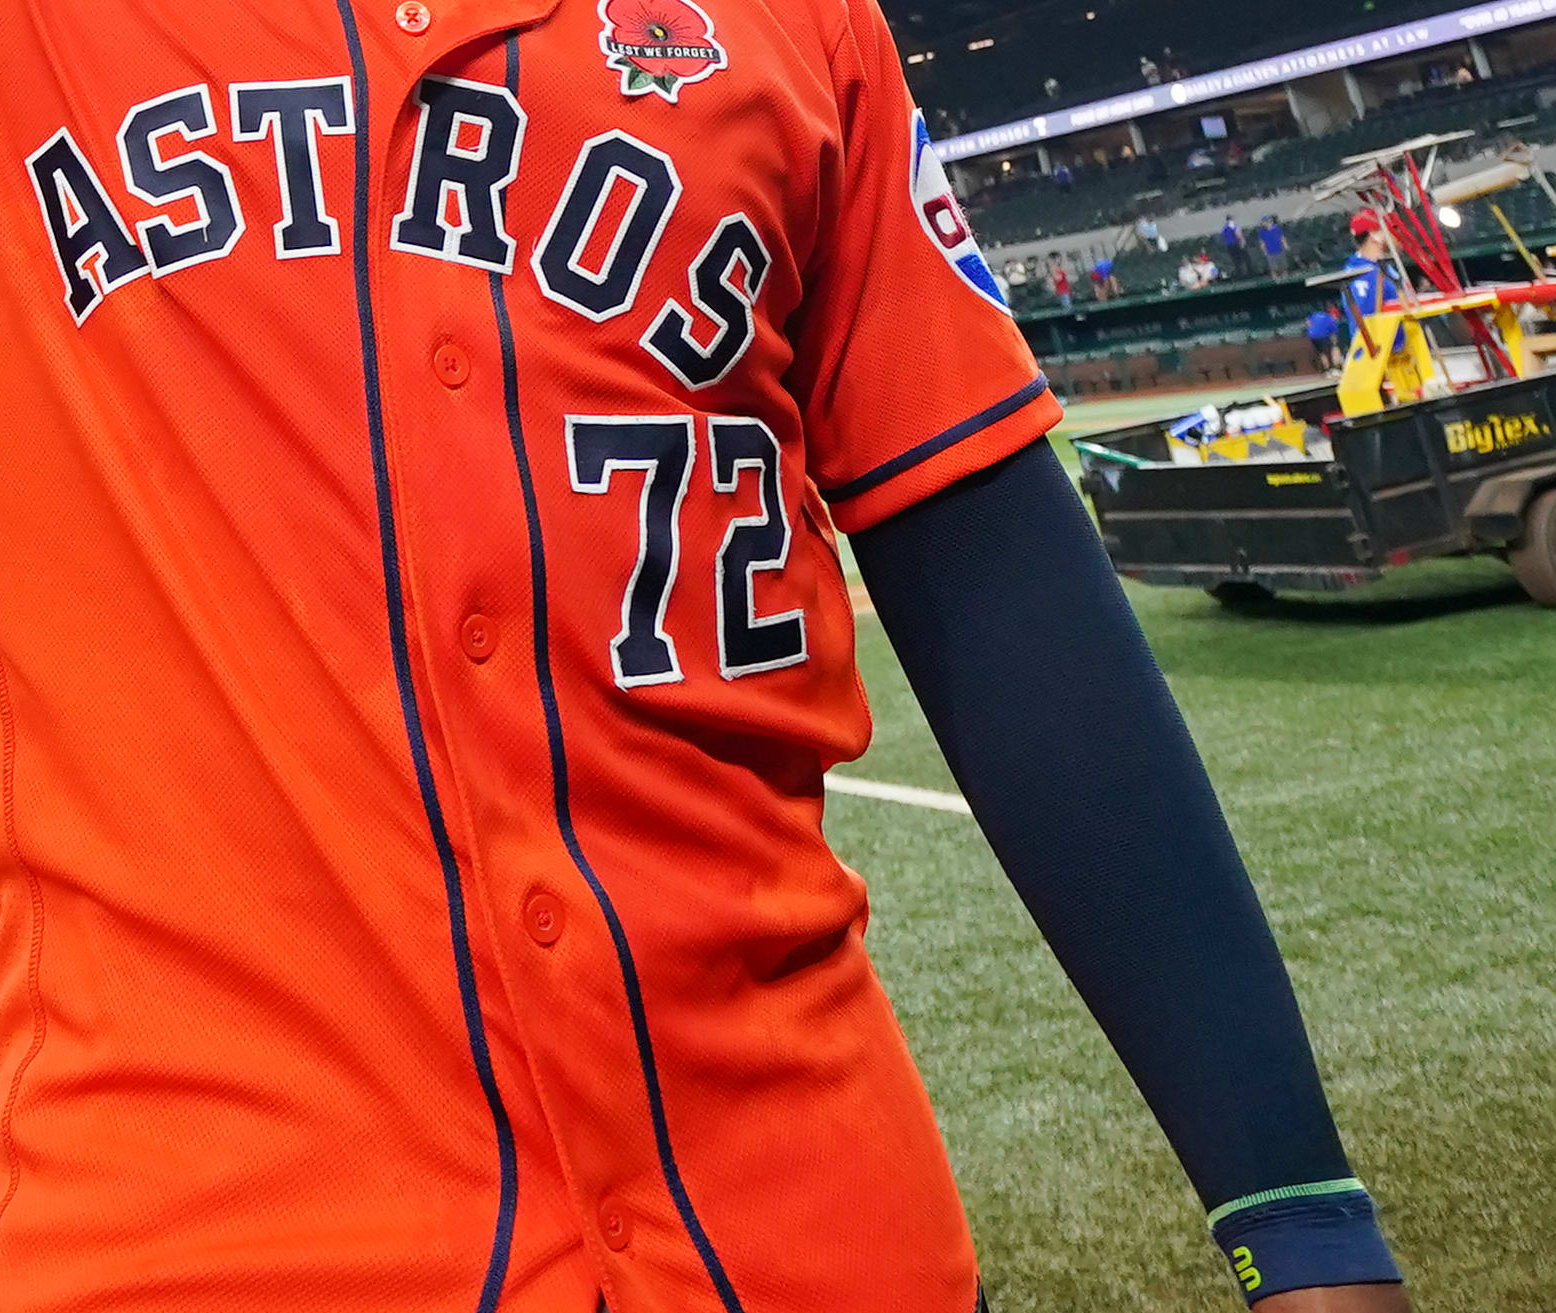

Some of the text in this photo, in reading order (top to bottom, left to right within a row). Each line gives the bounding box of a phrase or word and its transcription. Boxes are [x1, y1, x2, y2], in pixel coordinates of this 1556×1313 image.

[610, 42, 715, 59] LEST WE FORGET
[1396, 26, 1430, 46] LAW
[25, 74, 773, 388] ASTROS
[564, 414, 809, 691] 72
